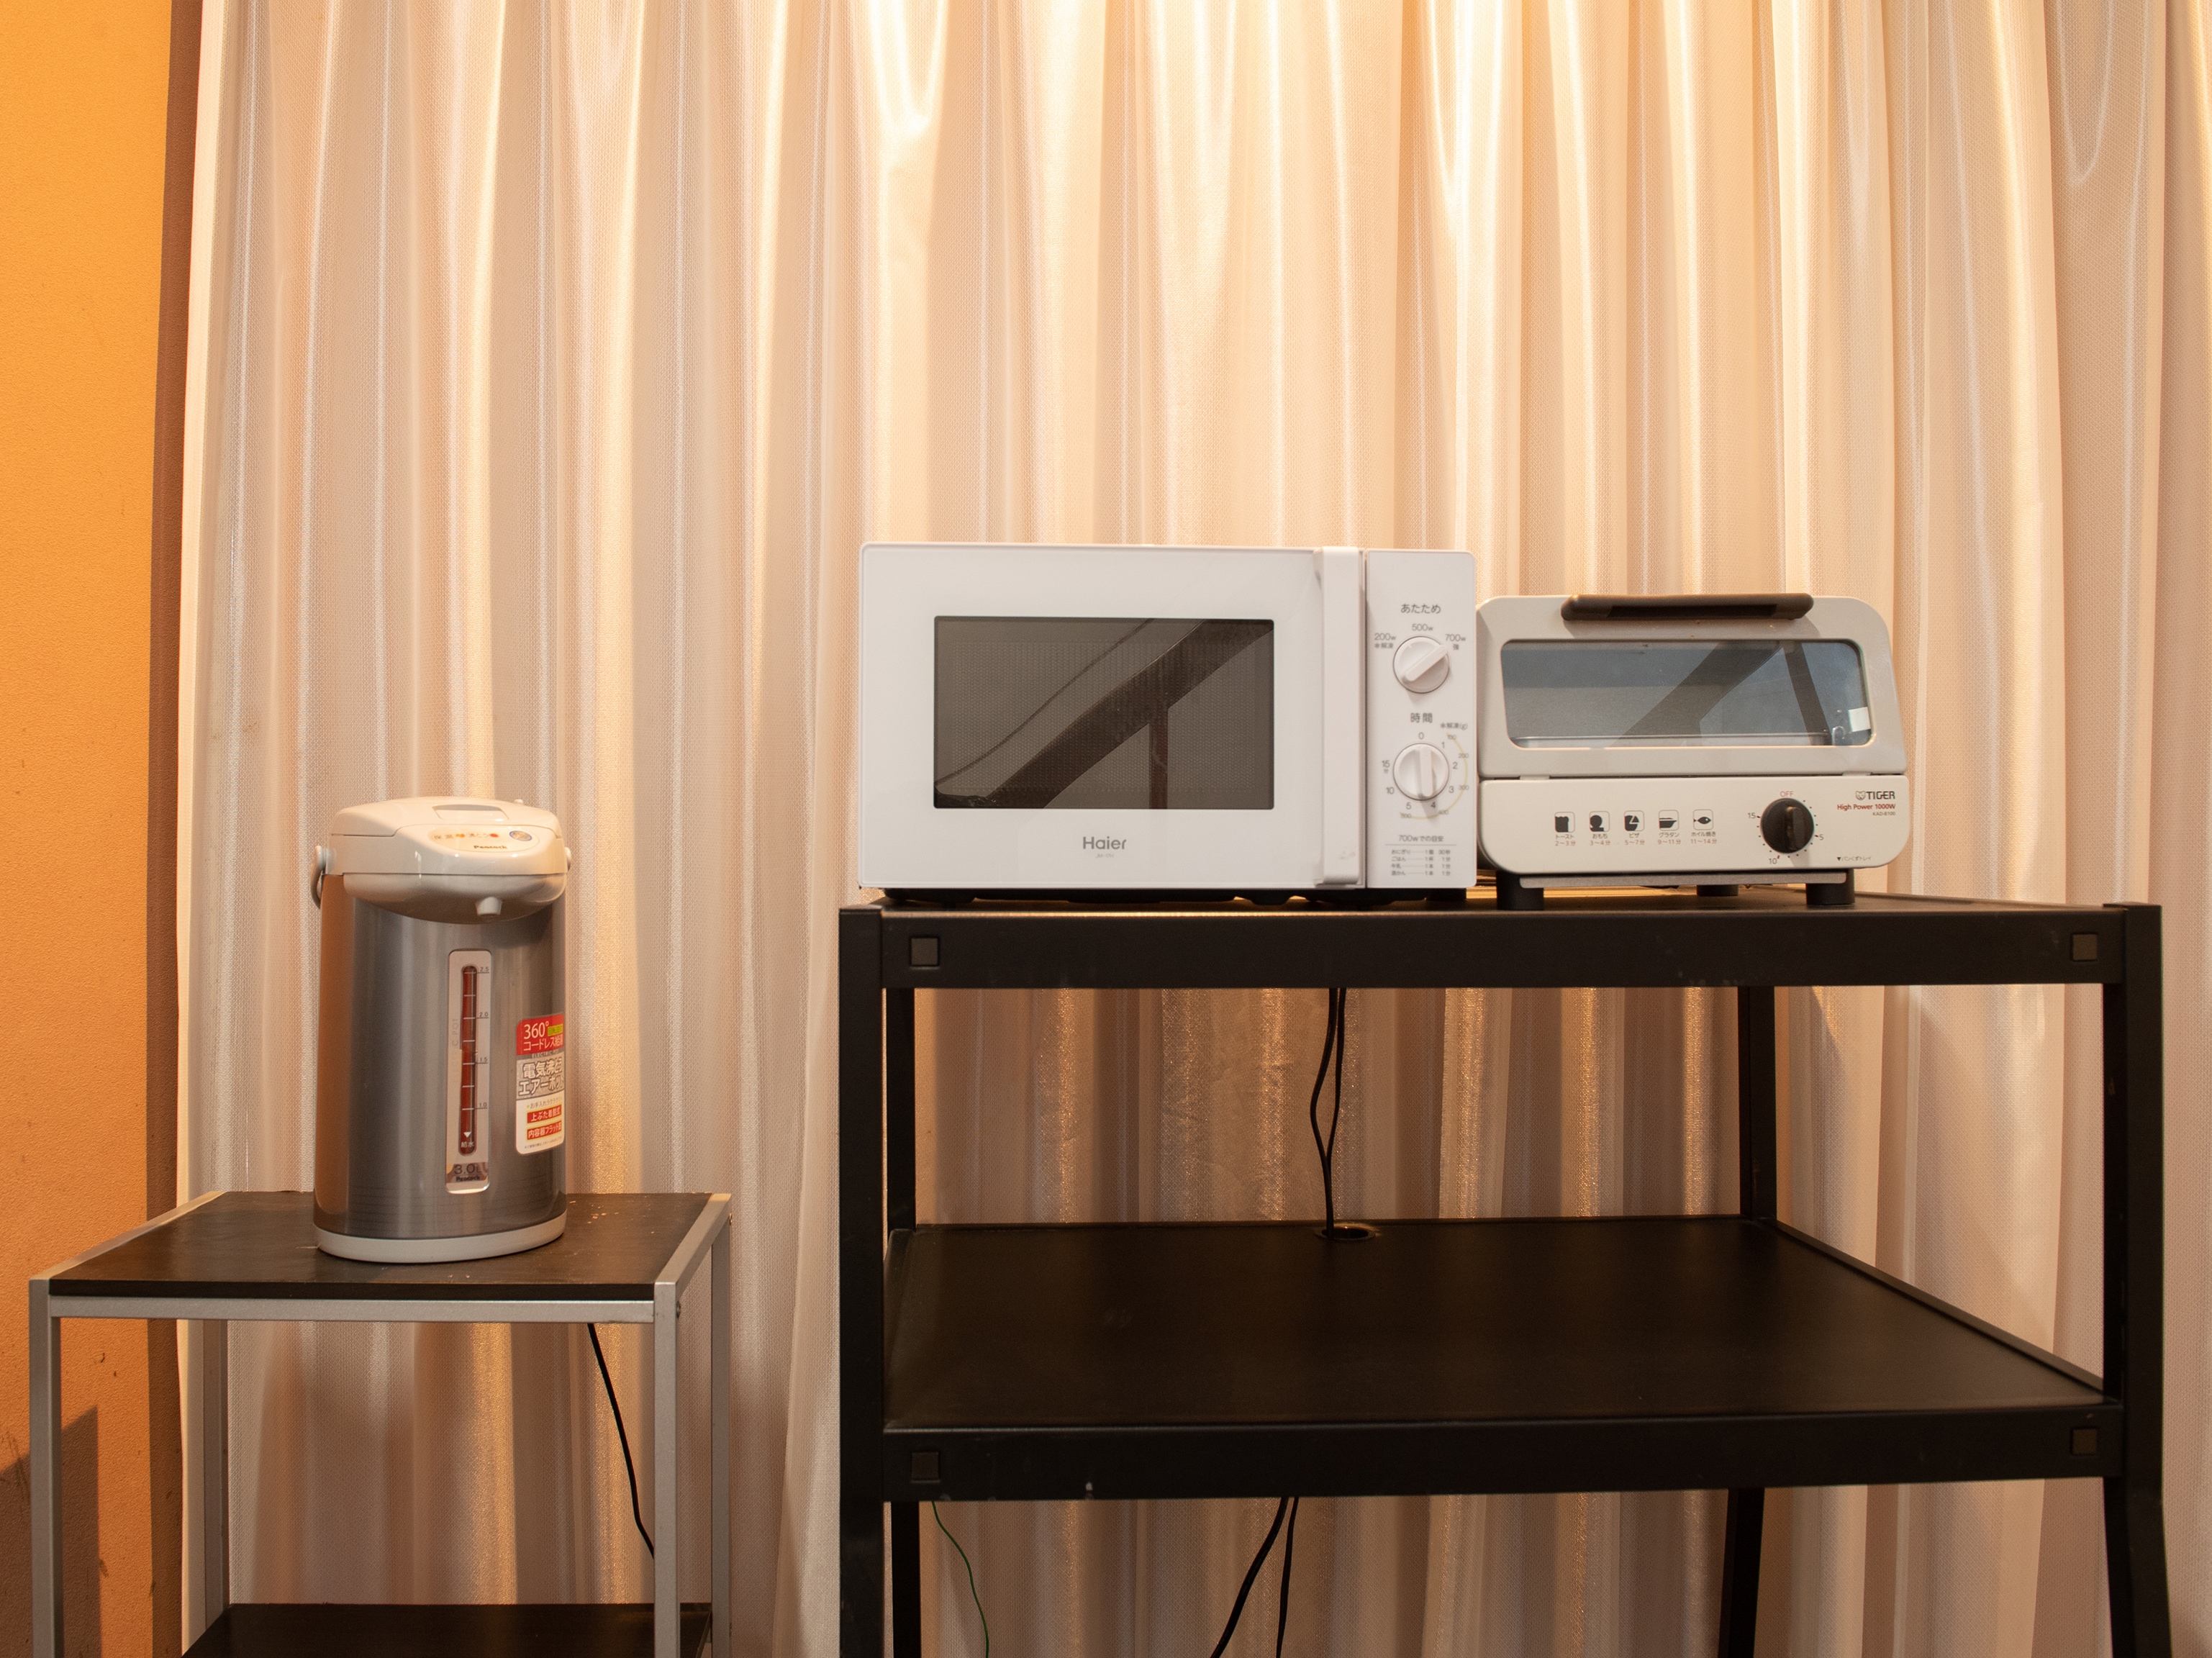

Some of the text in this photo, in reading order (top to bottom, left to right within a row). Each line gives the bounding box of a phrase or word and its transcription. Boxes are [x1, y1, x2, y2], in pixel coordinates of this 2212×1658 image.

[1400, 604, 1441, 614] あたため
[1410, 712, 1433, 723] 時間
[1866, 791, 1895, 799] TIGER
[1083, 836, 1127, 849] Haier
